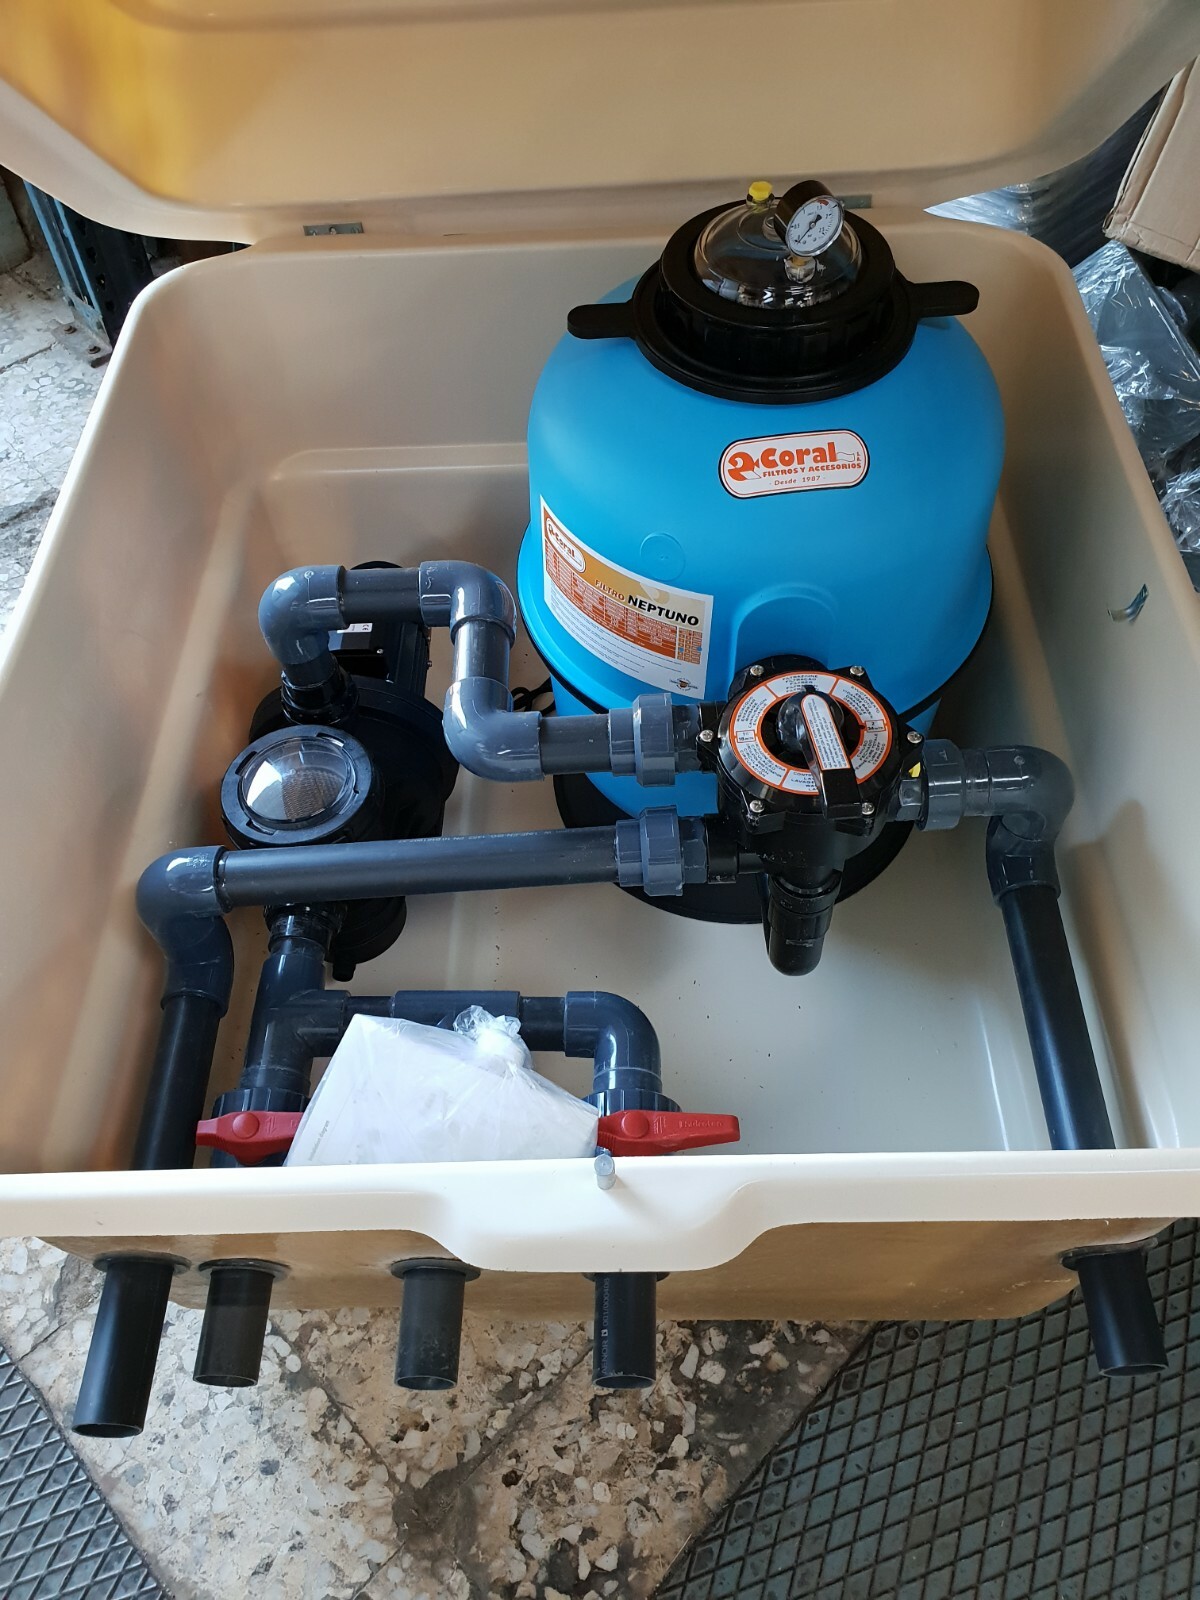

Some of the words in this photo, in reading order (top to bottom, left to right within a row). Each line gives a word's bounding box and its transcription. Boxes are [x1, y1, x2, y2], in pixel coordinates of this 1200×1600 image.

[760, 442, 837, 469] Coral
[762, 467, 798, 478] FILTROS
[808, 462, 862, 472] ACCESORIOS
[774, 478, 797, 486] Desde
[802, 475, 821, 483] 1987
[595, 579, 625, 601] FILTRO
[628, 594, 699, 626] NEPTUNO
[601, 1339, 609, 1376] AENOR
